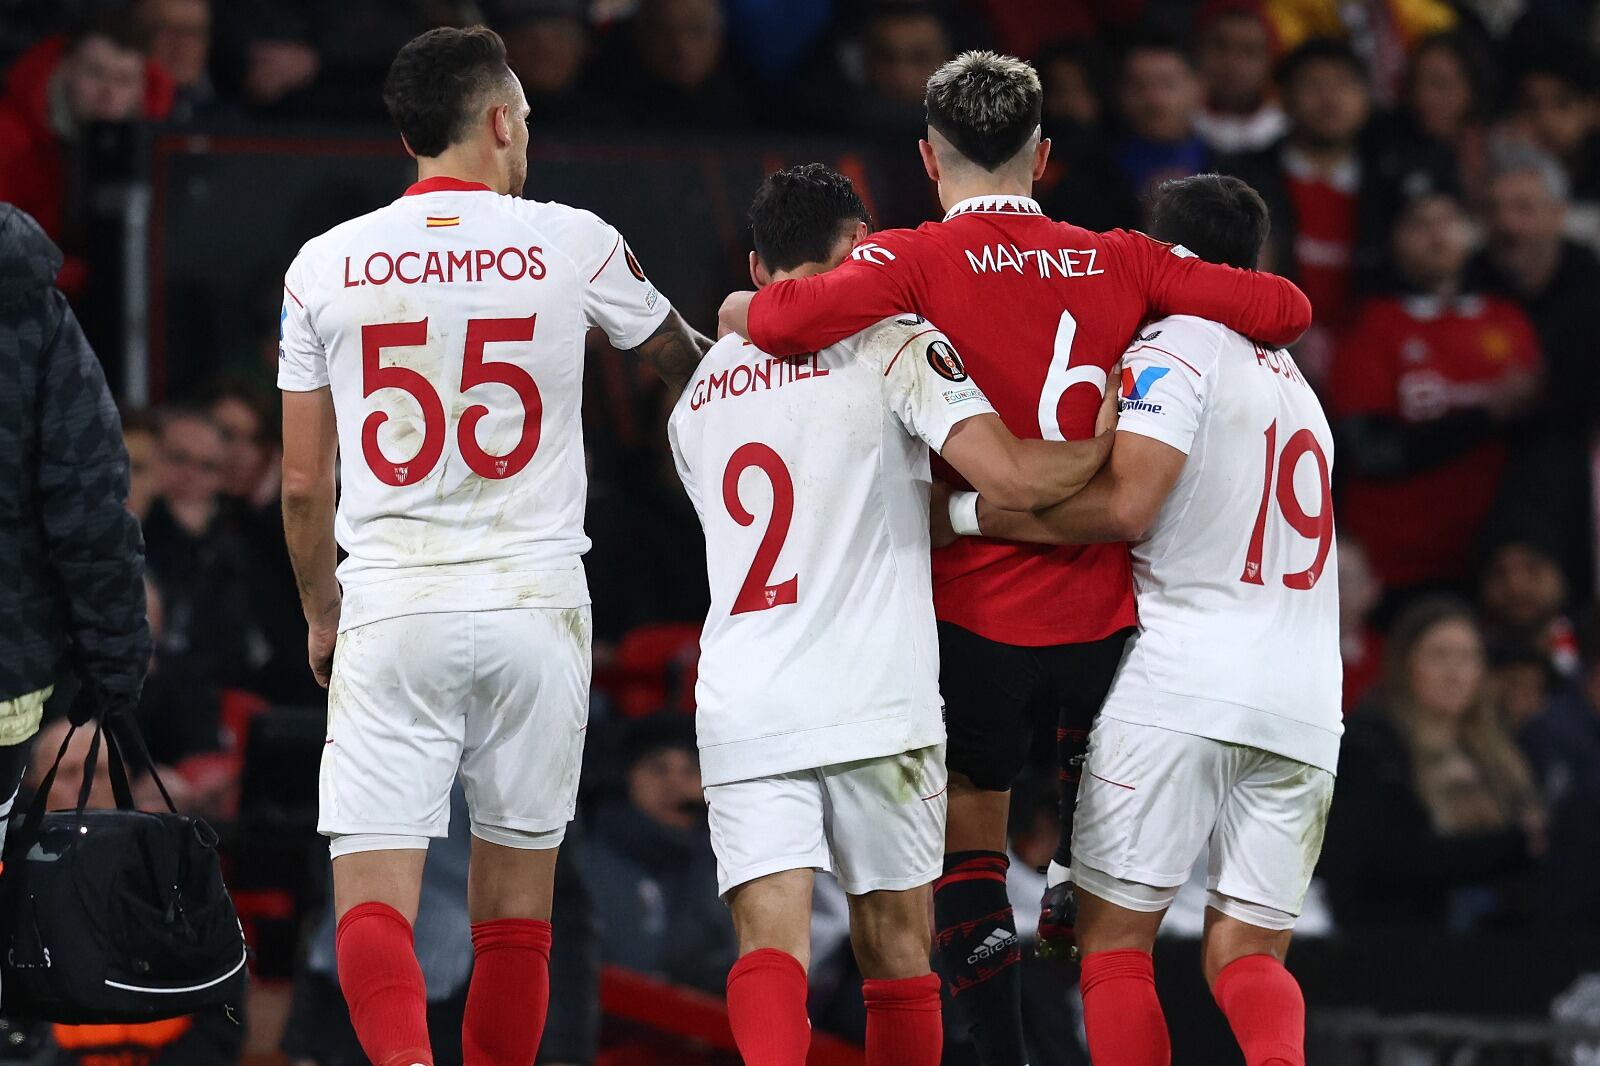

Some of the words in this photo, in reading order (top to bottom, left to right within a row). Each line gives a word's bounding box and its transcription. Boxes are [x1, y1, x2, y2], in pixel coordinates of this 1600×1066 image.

[344, 246, 546, 288] L.OCAMPOS
[361, 313, 542, 487] 55
[690, 351, 830, 411] G.MONTIEL
[1037, 308, 1106, 441] 6
[722, 442, 798, 616] 2
[1240, 417, 1334, 591] 19
